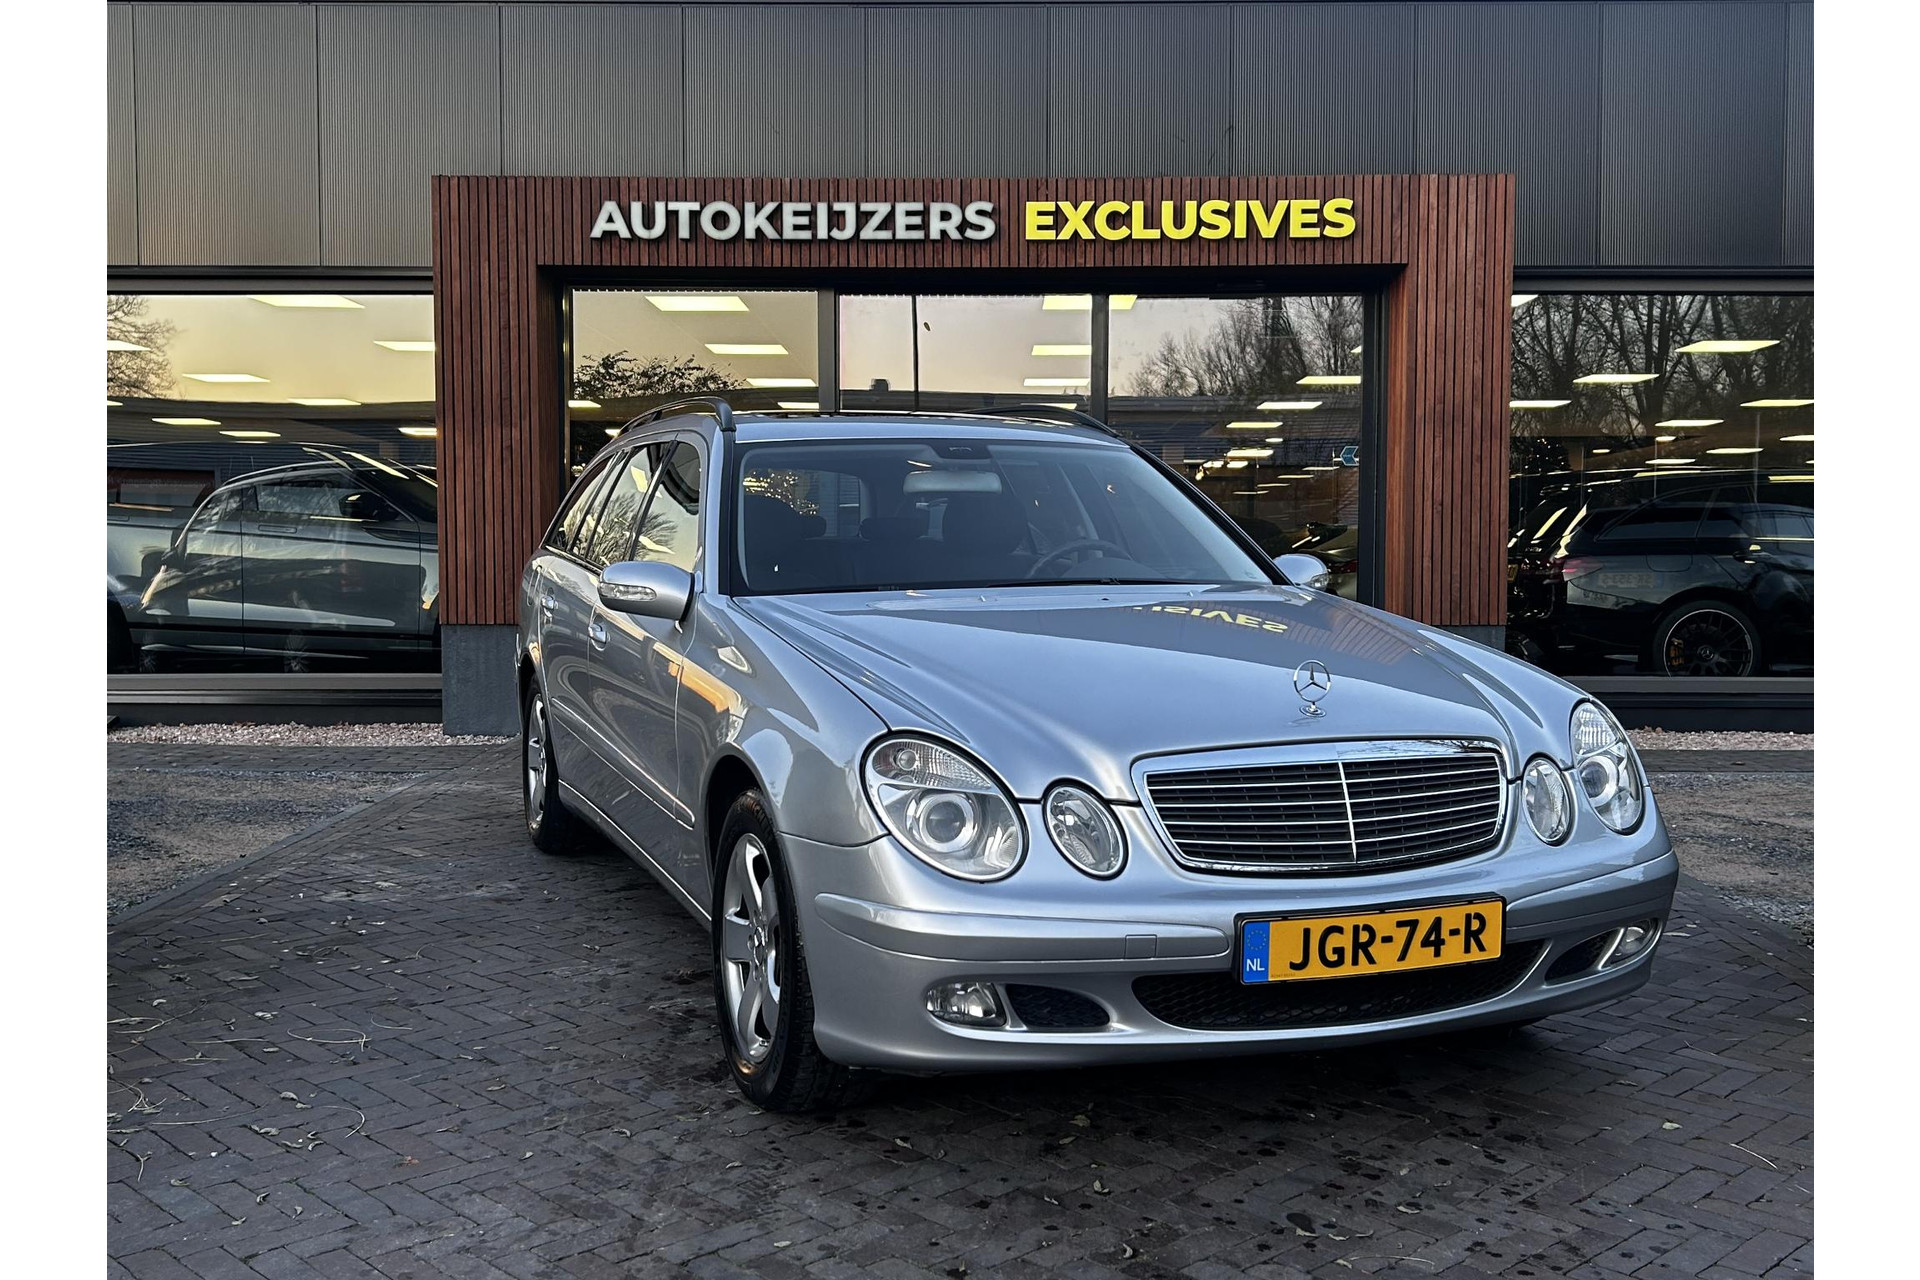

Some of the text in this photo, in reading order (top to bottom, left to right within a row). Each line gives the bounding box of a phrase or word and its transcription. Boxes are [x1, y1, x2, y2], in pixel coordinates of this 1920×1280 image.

[590, 198, 1356, 241] AUTOKEIJZERS EXCLUSIVES
[1246, 912, 1488, 972] NL JGR-74-R
